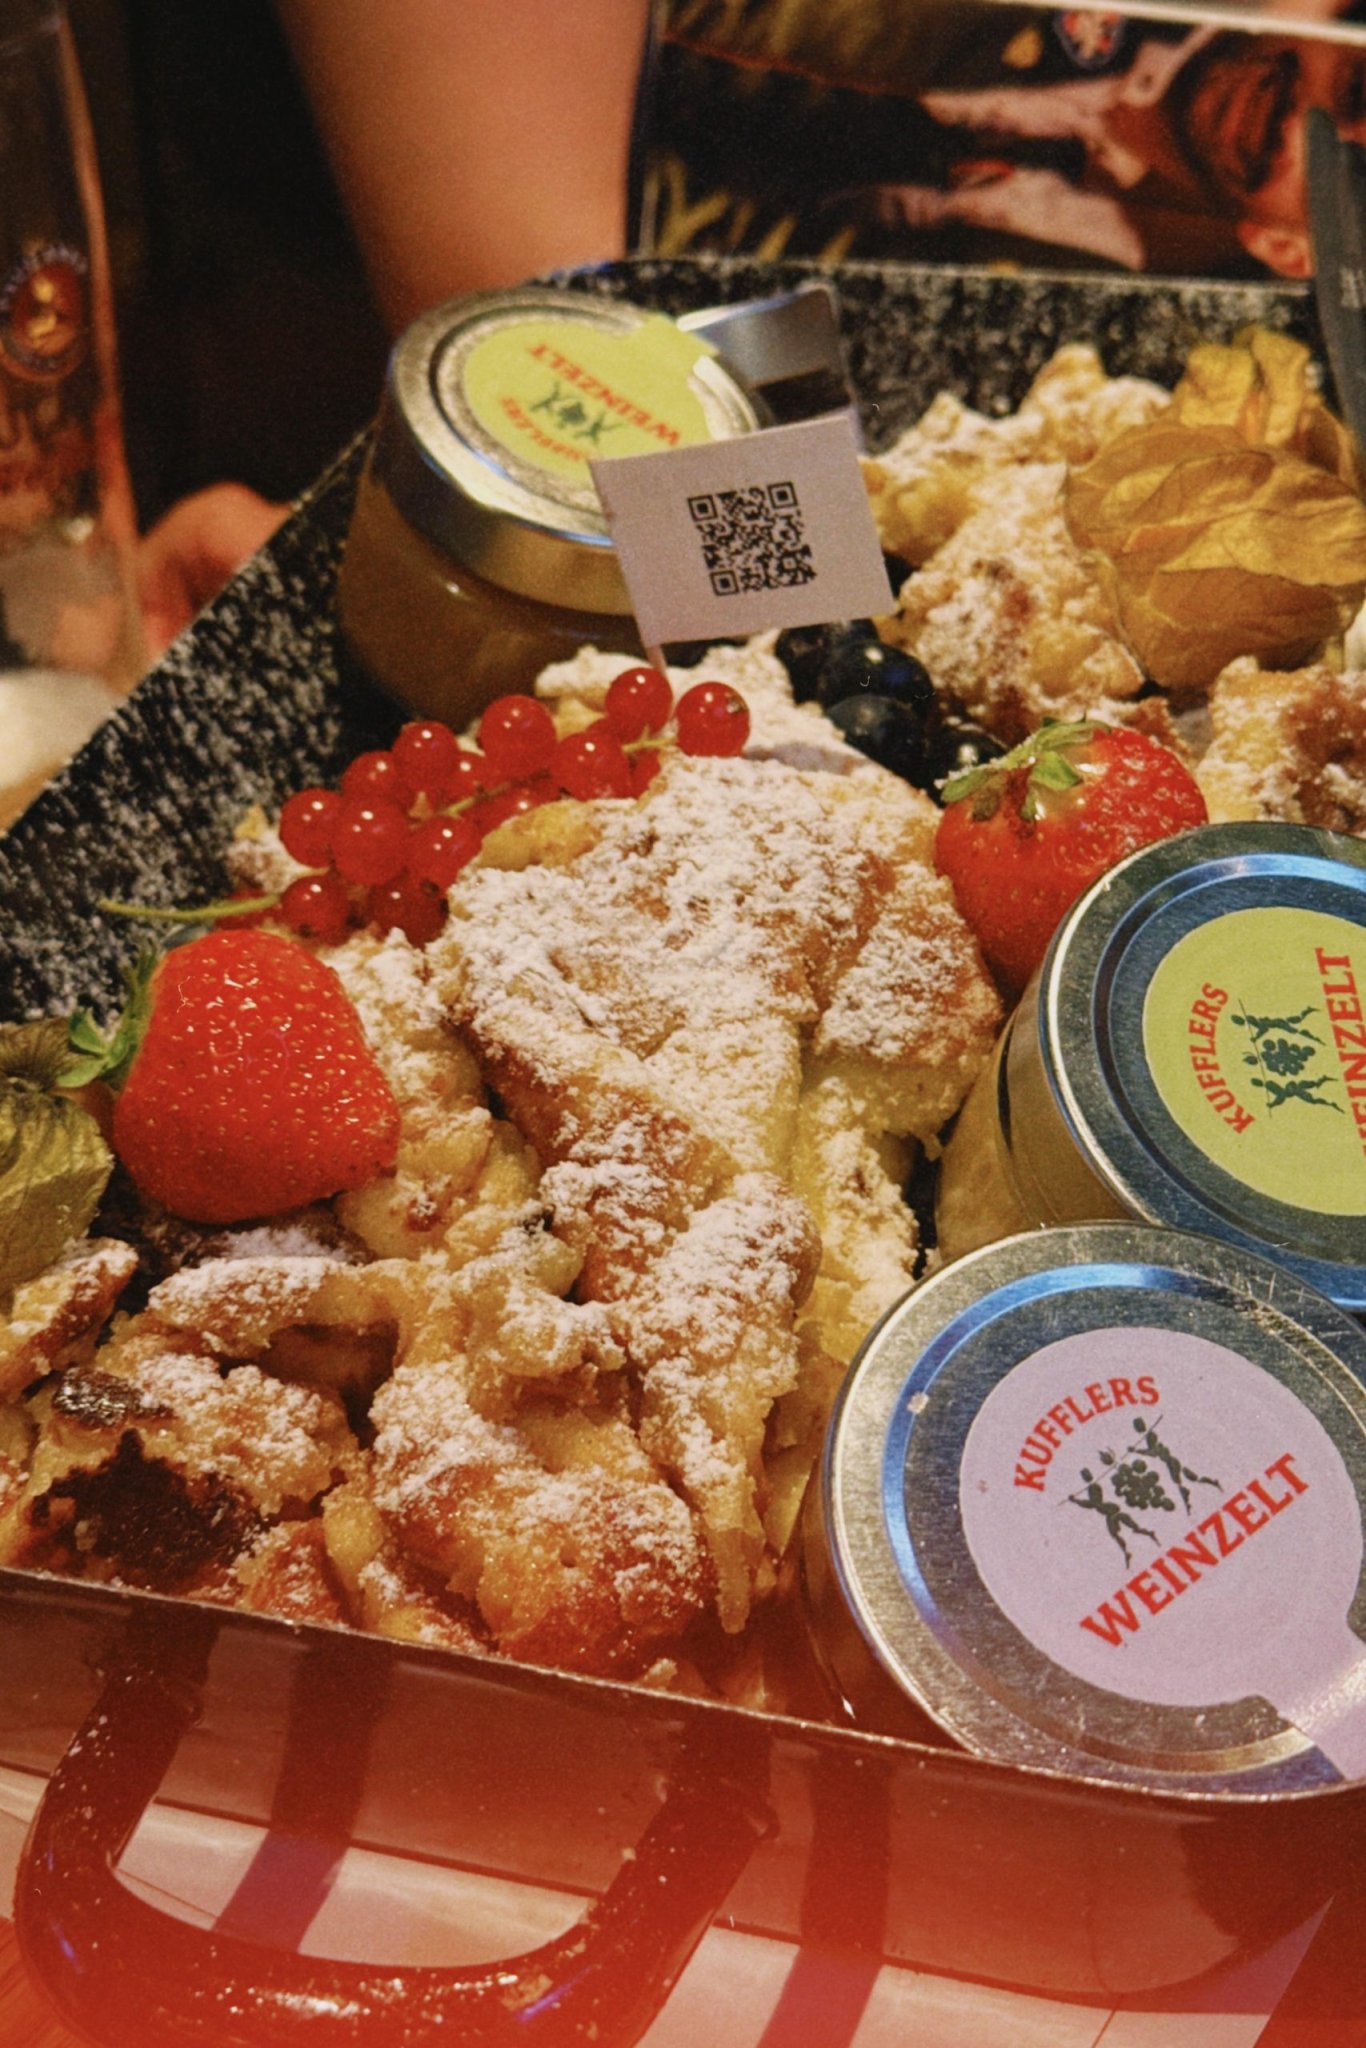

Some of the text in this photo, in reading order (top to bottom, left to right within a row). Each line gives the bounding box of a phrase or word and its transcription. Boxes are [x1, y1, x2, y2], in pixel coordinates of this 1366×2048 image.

[529, 343, 681, 446] WEINZELT
[1188, 983, 1256, 1134] KUFFLERS
[1315, 947, 1366, 1156] INZELT
[1013, 1375, 1160, 1493] KUFFLERS
[1079, 1452, 1309, 1648] WEINZELT
